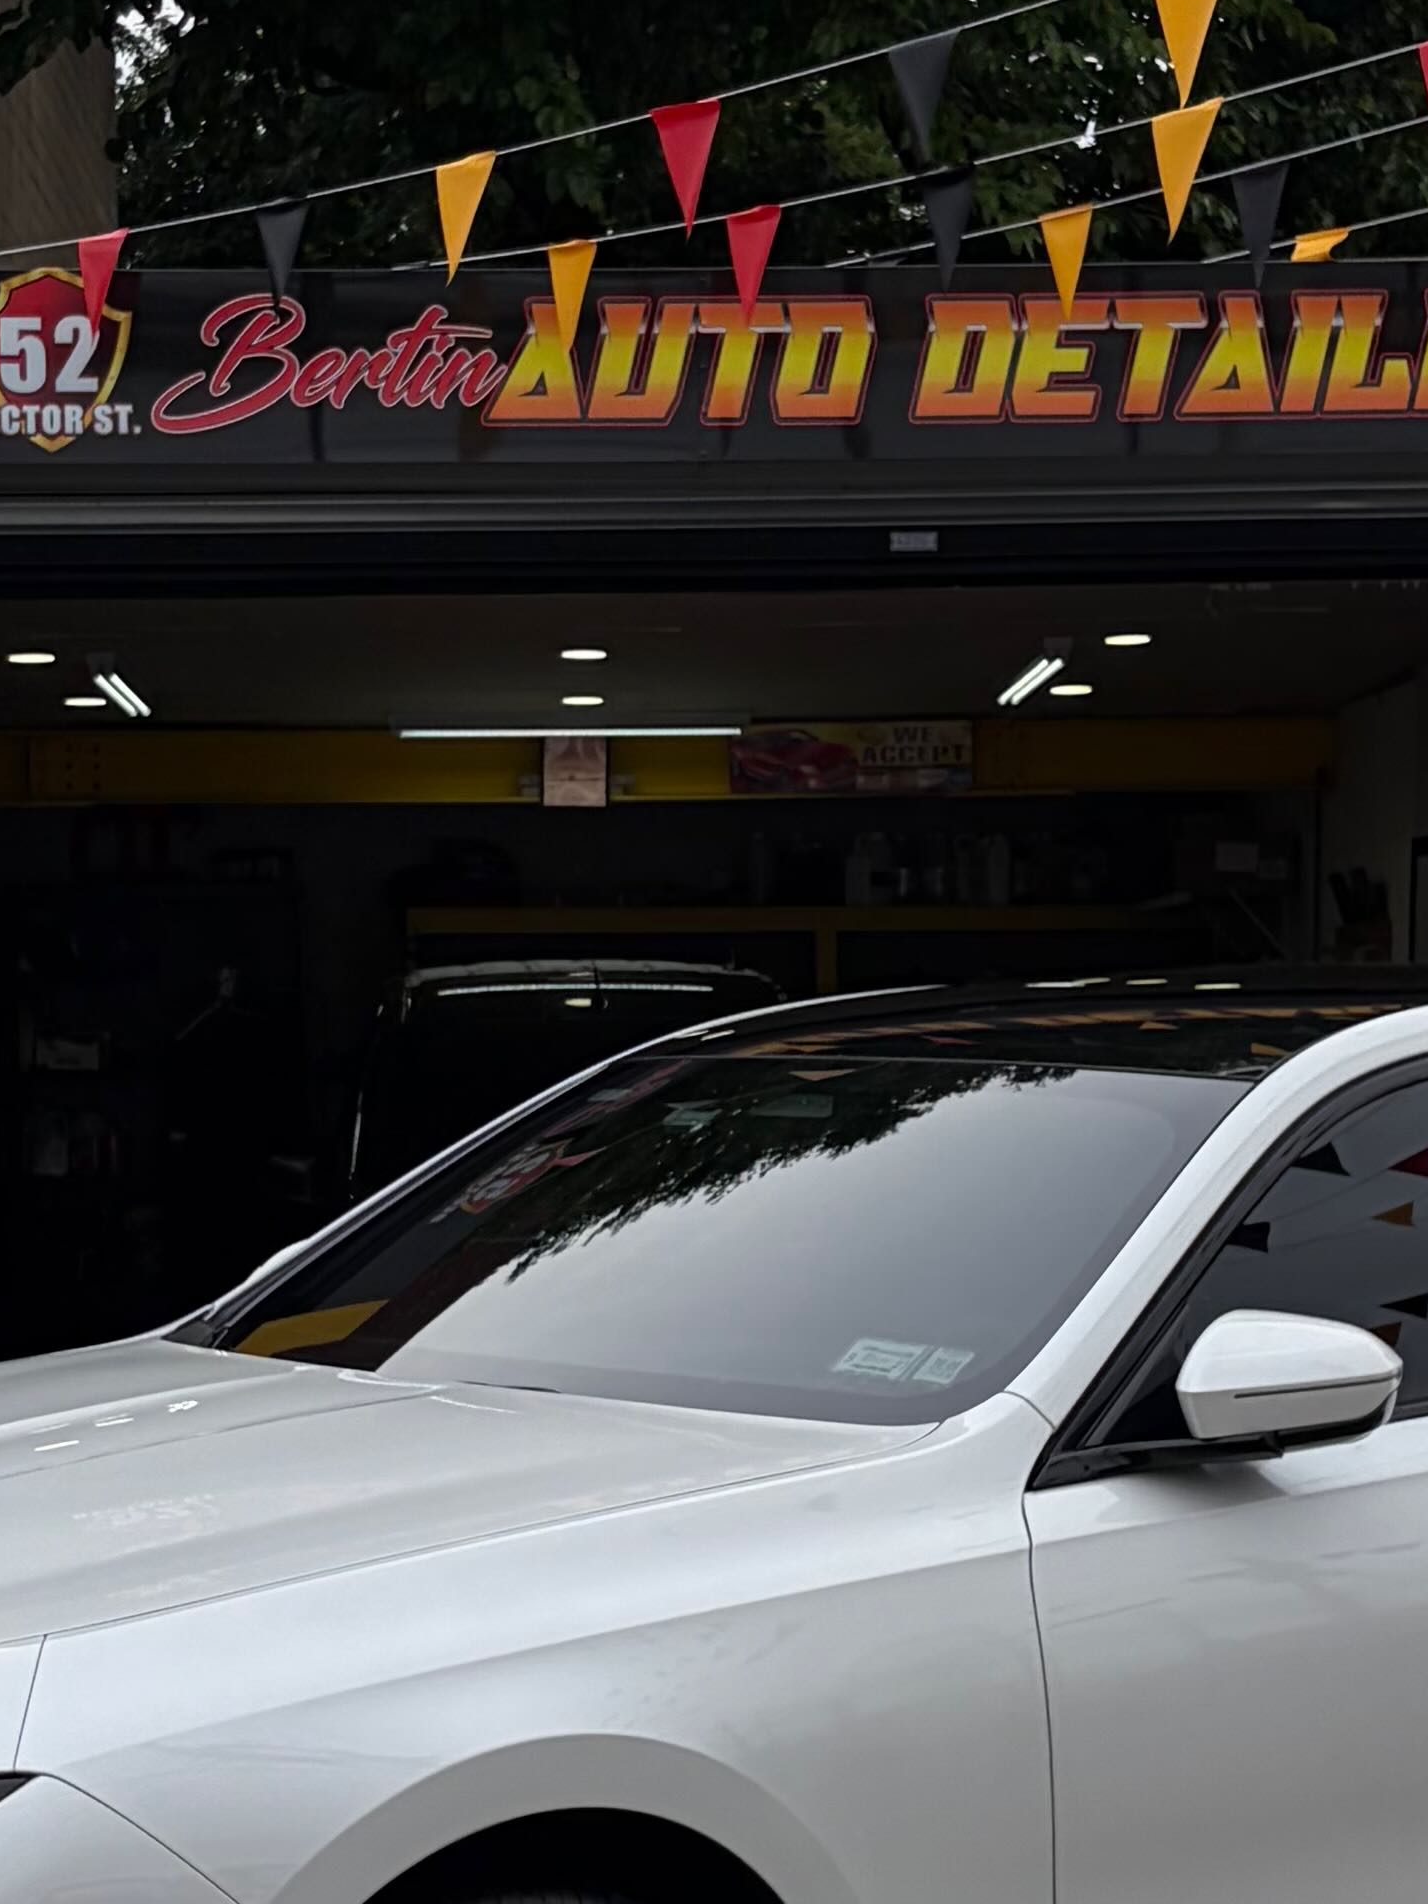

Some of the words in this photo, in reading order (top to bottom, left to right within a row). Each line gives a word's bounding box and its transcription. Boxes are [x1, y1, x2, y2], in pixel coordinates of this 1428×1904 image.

[151, 293, 508, 433] Bertin
[481, 295, 876, 428] AUTO
[93, 403, 142, 436] ST.
[892, 727, 935, 744] WE
[861, 745, 965, 764] ACCEPT
